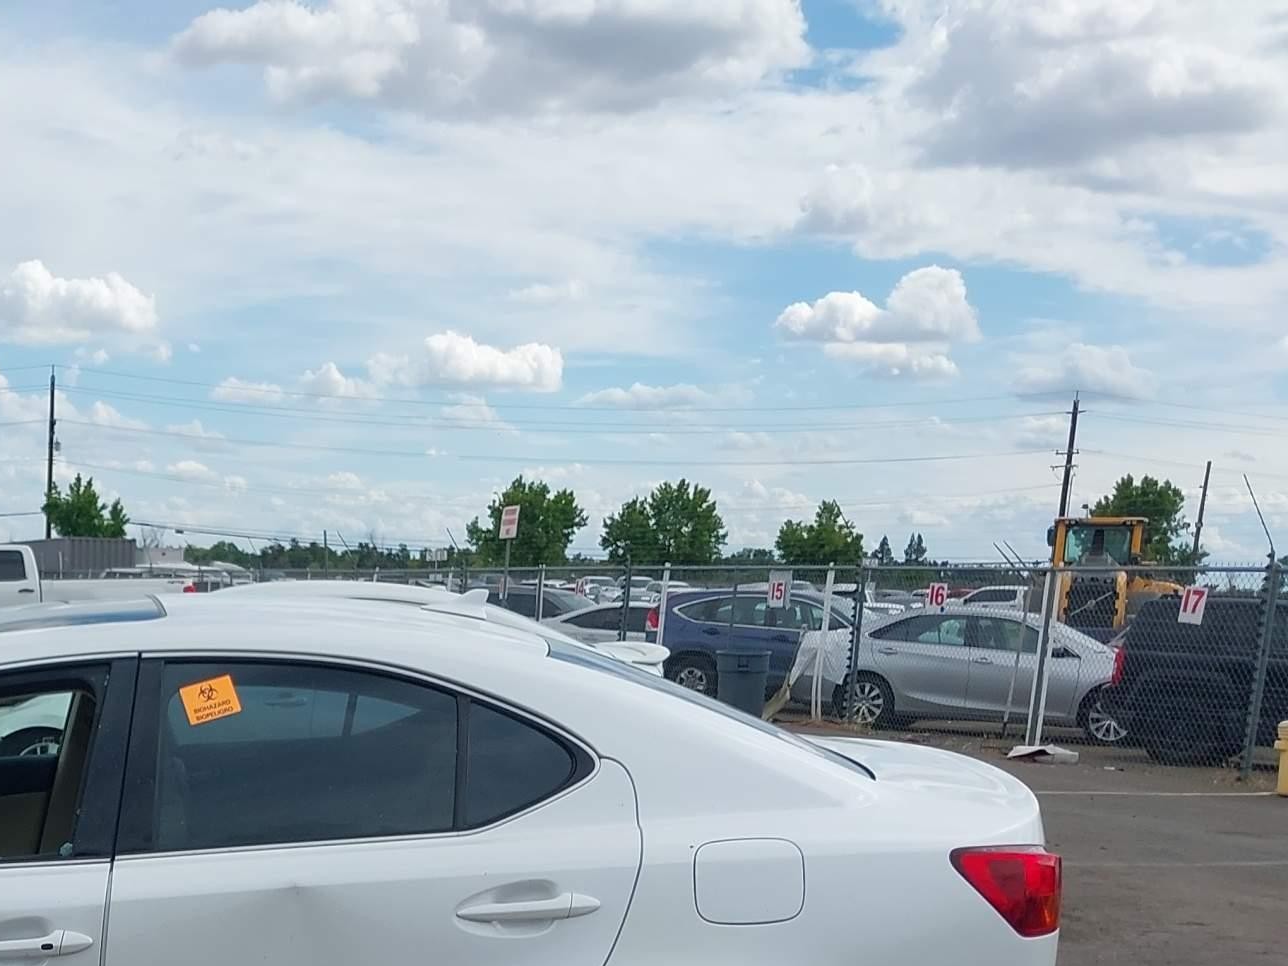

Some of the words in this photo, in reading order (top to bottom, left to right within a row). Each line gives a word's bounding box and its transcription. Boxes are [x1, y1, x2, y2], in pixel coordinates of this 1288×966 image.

[771, 582, 783, 601] 15
[929, 585, 945, 606] 16
[1182, 588, 1205, 614] 17
[193, 699, 231, 714] BIOHAZARD
